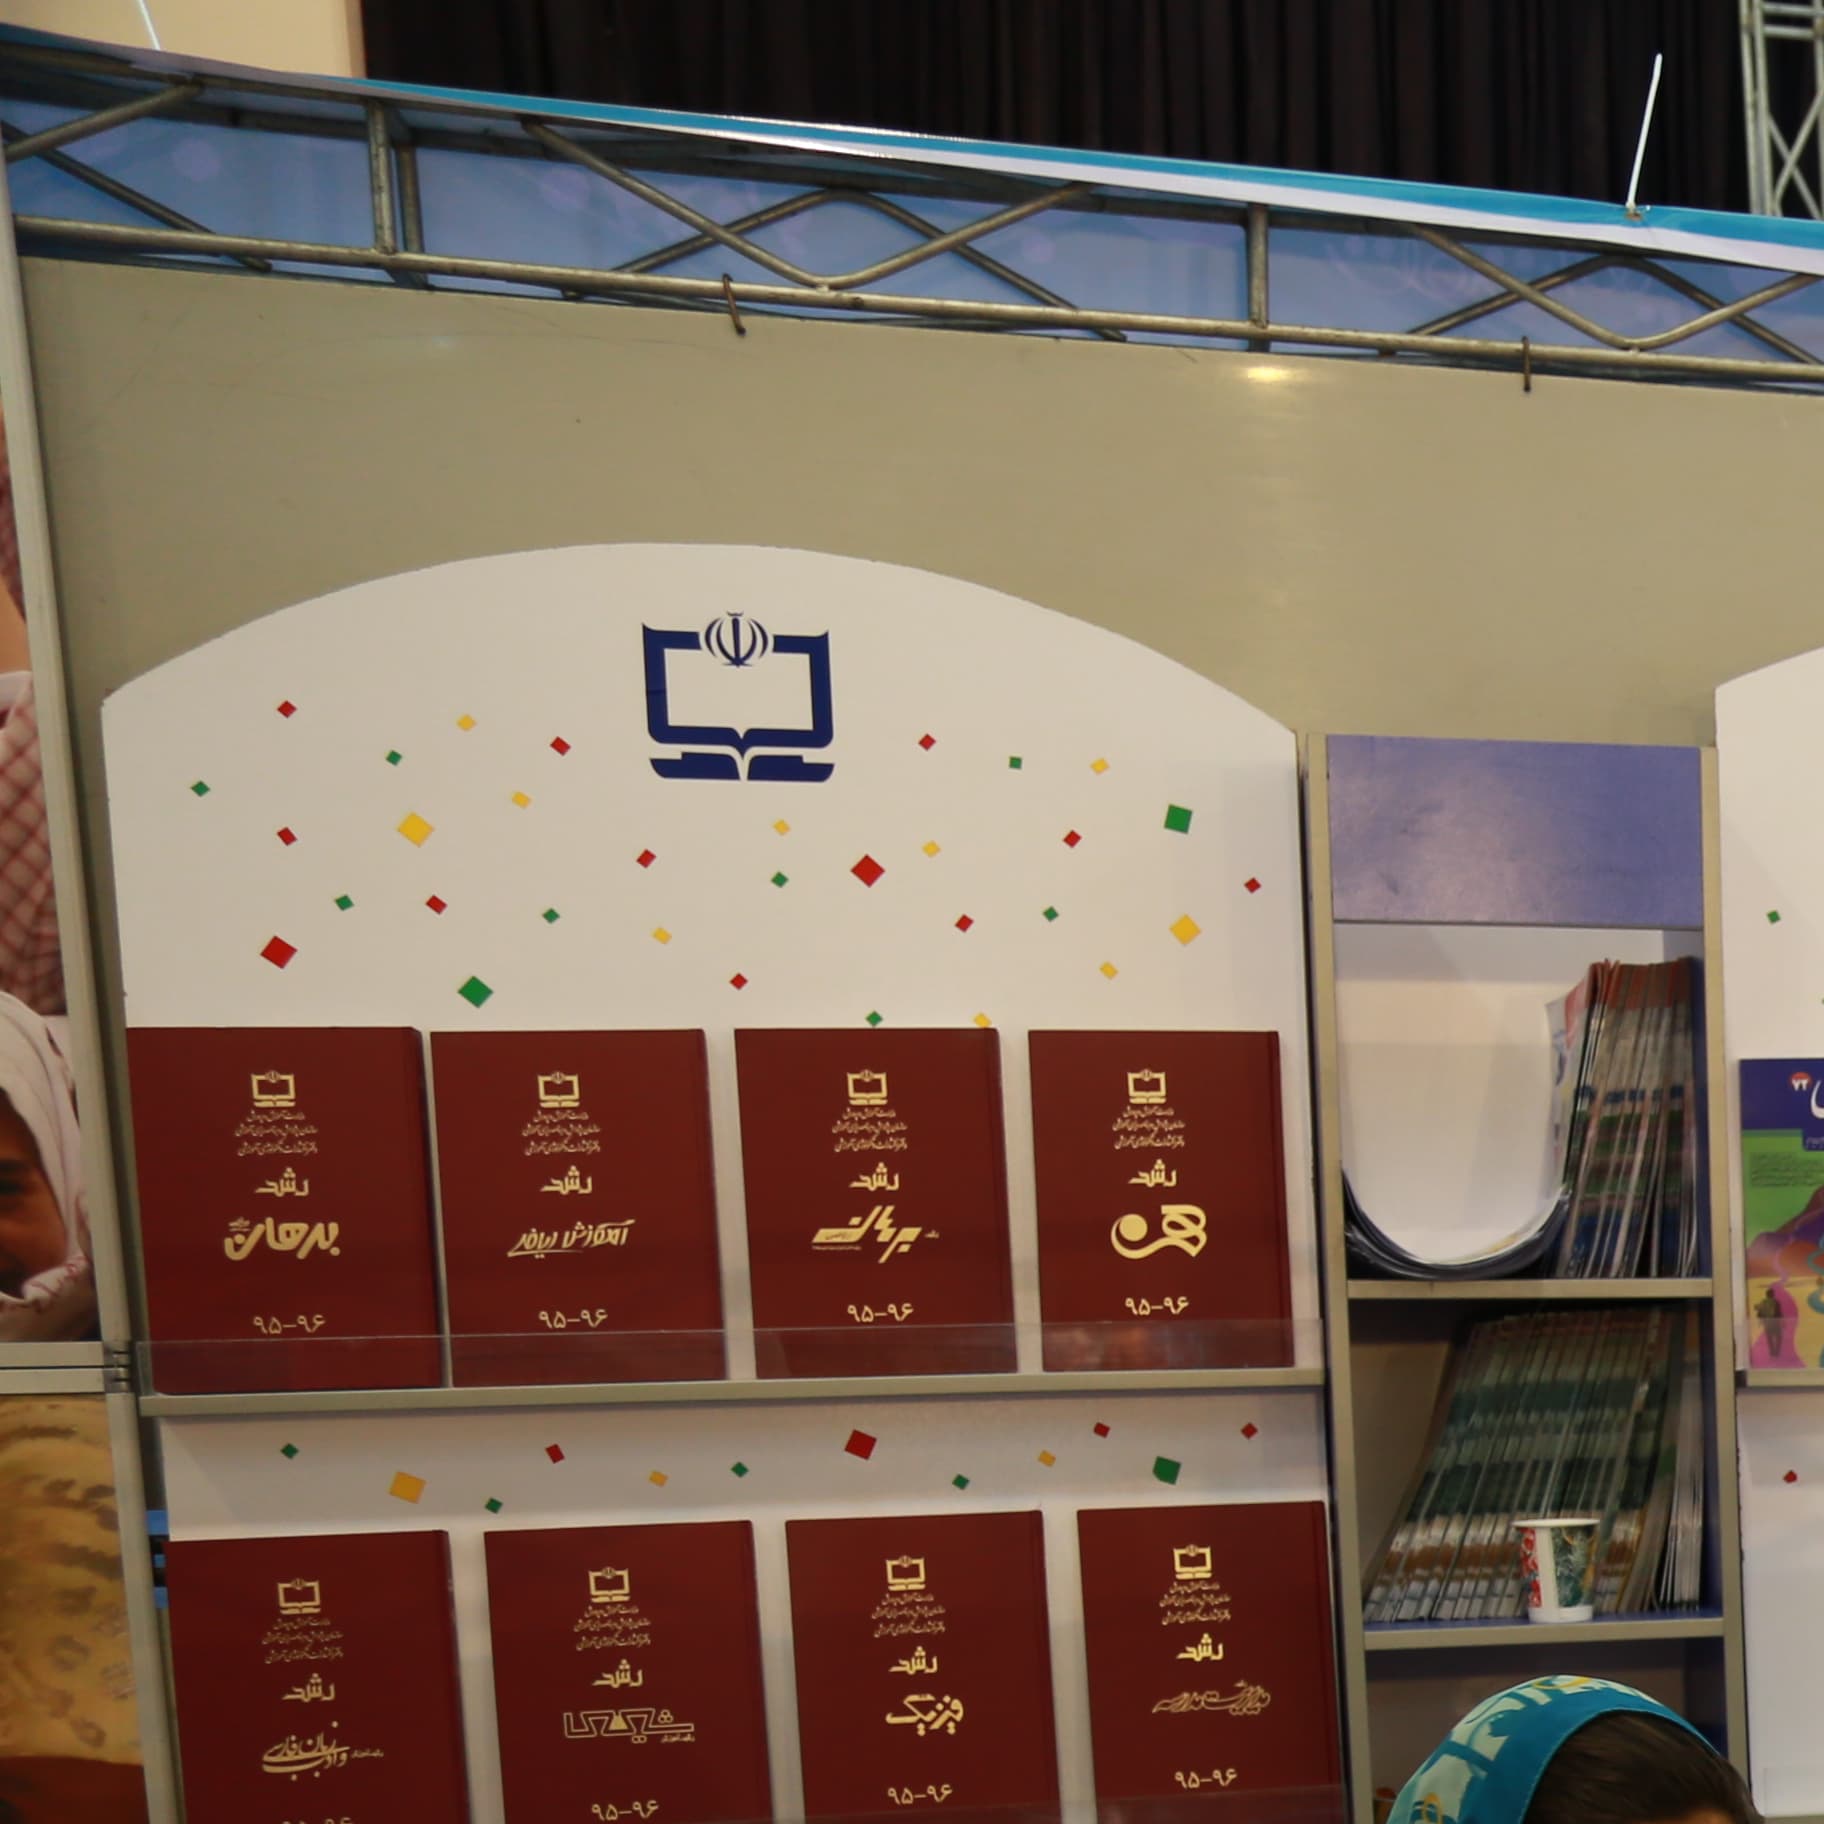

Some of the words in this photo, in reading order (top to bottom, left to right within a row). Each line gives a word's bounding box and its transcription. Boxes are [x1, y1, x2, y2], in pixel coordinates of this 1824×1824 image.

[255, 1166, 310, 1197] رشد
[540, 1165, 593, 1194] رشد
[849, 1162, 900, 1190] رشد
[1128, 1159, 1177, 1188] رشد
[224, 1216, 341, 1261] برهان
[561, 1220, 636, 1249] آموزش
[889, 1646, 938, 1674] رشد
[1176, 1633, 1224, 1661] رشد
[282, 1673, 335, 1702] رشد
[591, 1659, 643, 1687] رشد
[886, 1693, 964, 1736] فیزیک
